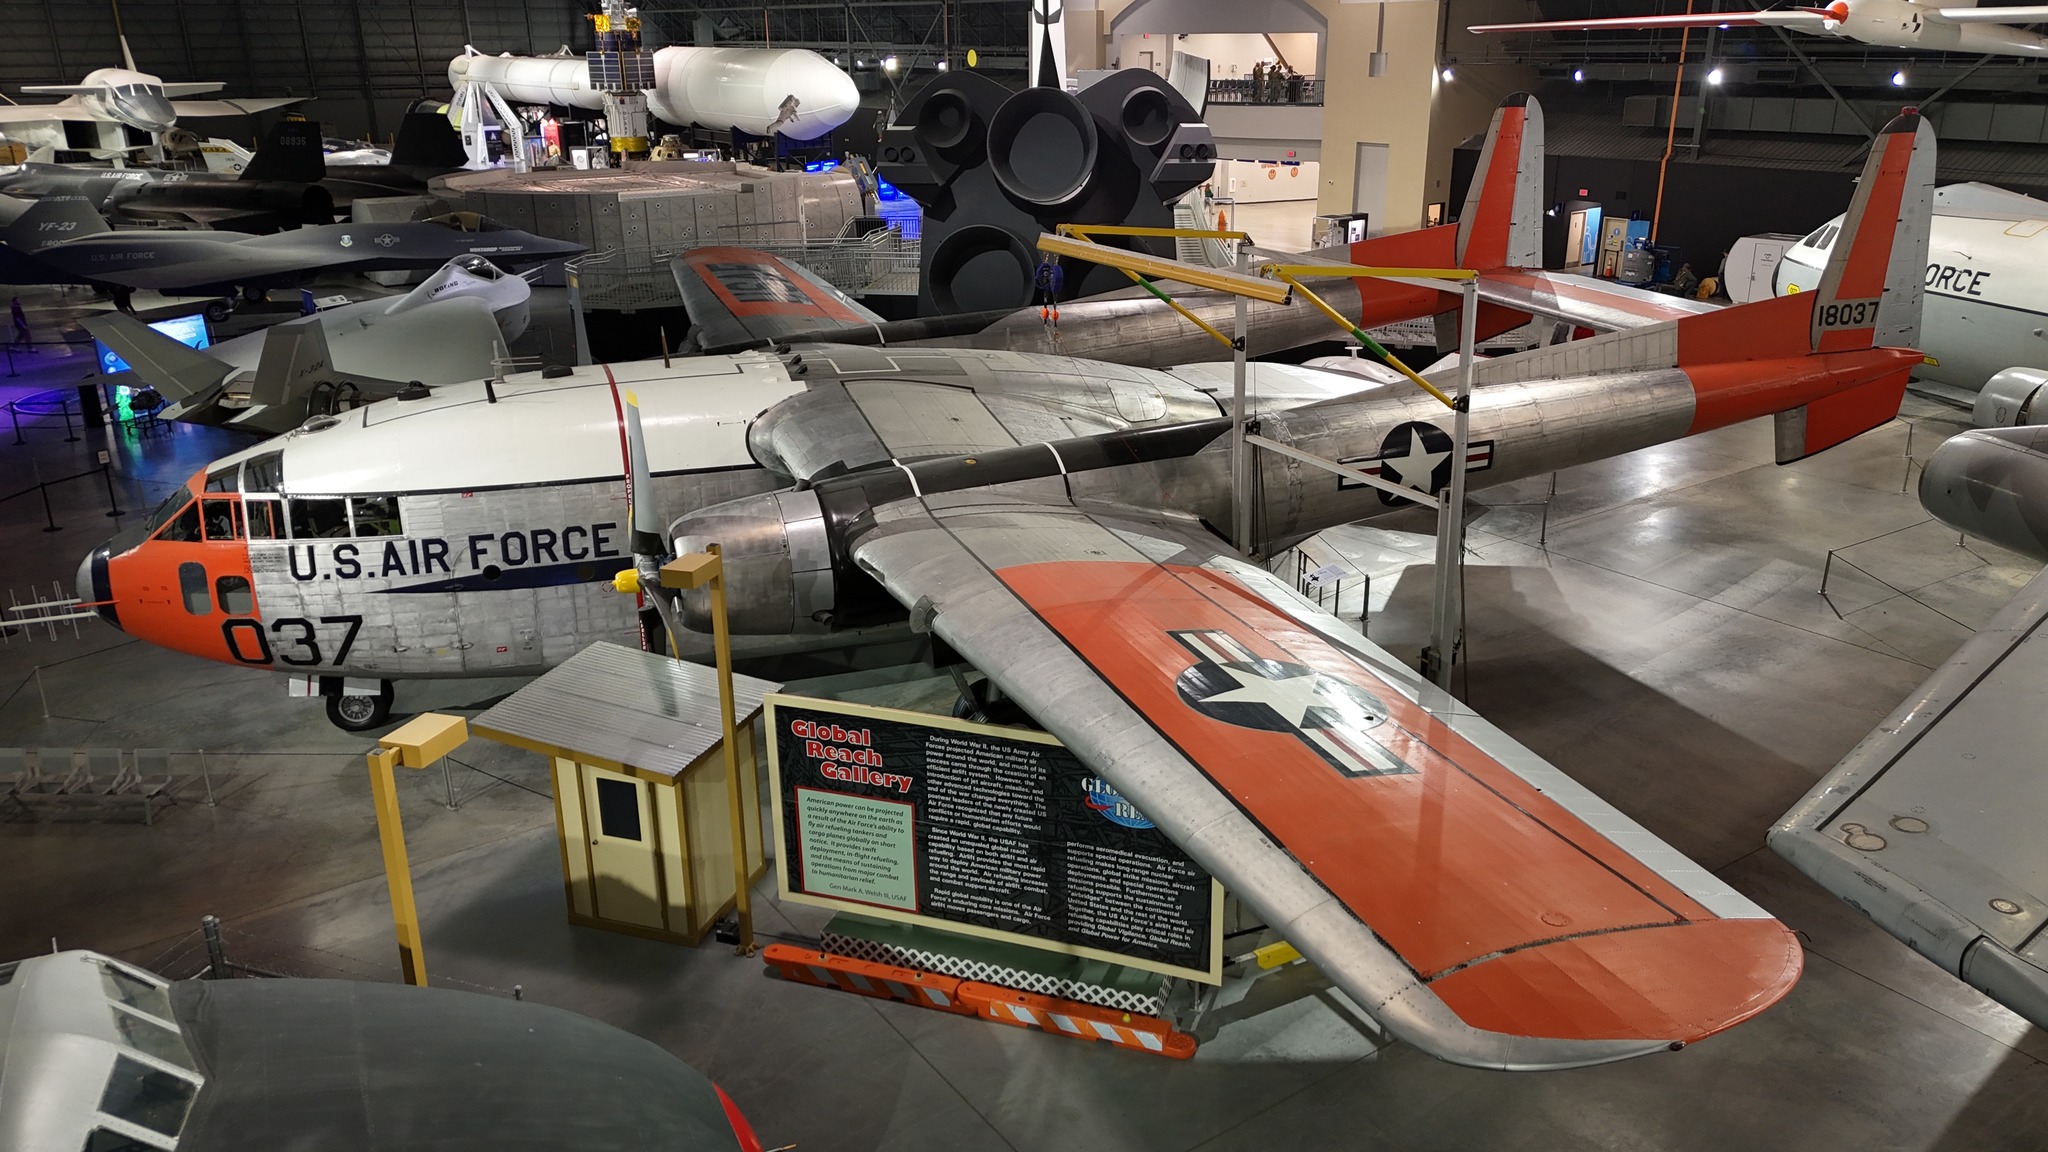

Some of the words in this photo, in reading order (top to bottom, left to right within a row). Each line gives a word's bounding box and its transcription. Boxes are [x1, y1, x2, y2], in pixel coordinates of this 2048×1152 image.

[38, 222, 77, 231] YF-23
[1925, 264, 1990, 296] ORCE
[1818, 302, 1879, 327] 18037
[468, 522, 620, 570] FORCE
[221, 614, 363, 666] 037
[791, 720, 870, 746] Global
[930, 736, 949, 744] During
[806, 740, 882, 767] Reach
[976, 750, 1003, 758] American
[969, 764, 991, 772] through
[820, 761, 913, 793] Gallery
[927, 771, 961, 781] introduction
[973, 787, 1010, 796] technologies
[807, 797, 834, 805] American
[825, 825, 851, 834] refueling
[847, 836, 870, 845] globally
[847, 851, 870, 860] in-flight
[1096, 847, 1133, 857] aeromedical
[811, 862, 842, 870] operations
[861, 863, 891, 872] sustaining
[819, 870, 858, 881] humanitarian
[1105, 898, 1131, 907] between
[1145, 907, 1180, 916] continental
